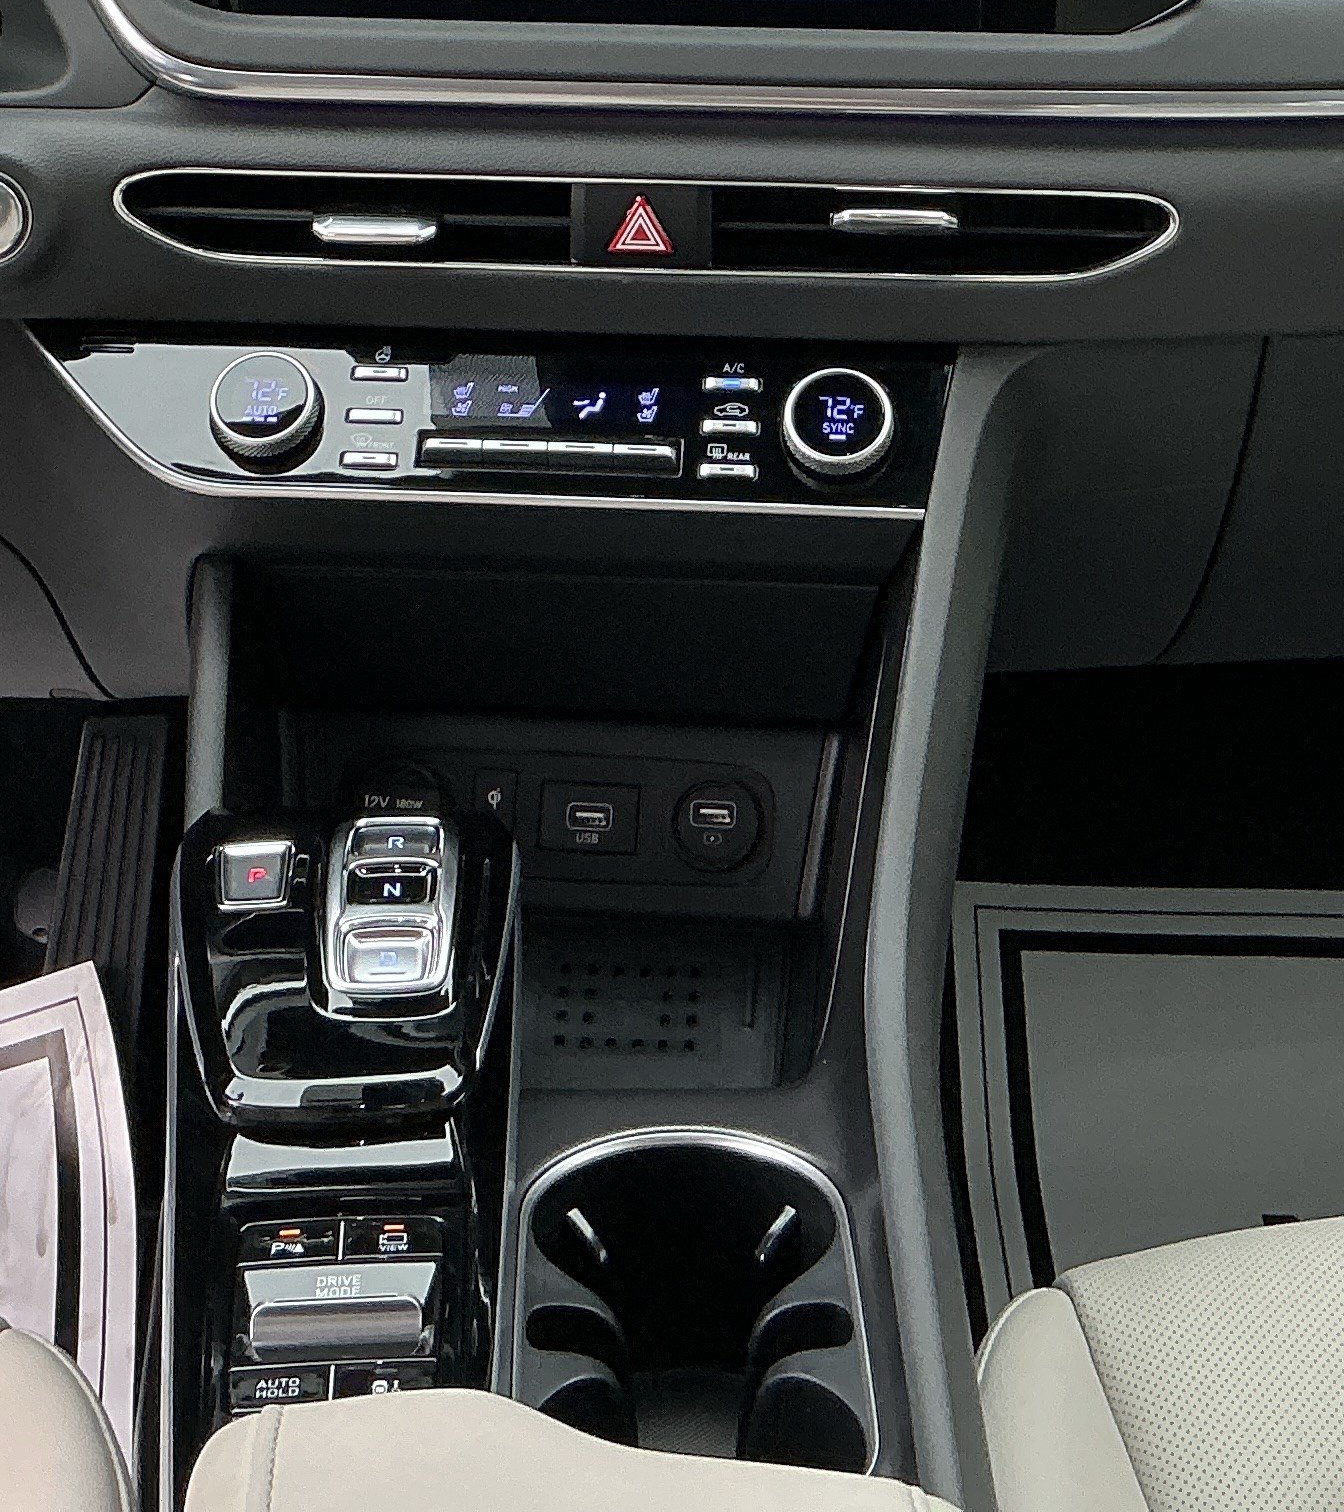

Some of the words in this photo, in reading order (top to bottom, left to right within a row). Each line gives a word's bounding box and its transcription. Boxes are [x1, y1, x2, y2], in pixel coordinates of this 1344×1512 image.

[722, 362, 745, 374] A/C
[365, 395, 387, 406] OFF
[243, 404, 278, 417] AUTO
[822, 422, 855, 435] SYNC
[726, 451, 751, 462] REAR
[363, 793, 390, 809] 12V
[387, 836, 405, 849] R
[575, 832, 600, 845] USB
[248, 867, 267, 884] P
[383, 882, 402, 898] N
[378, 950, 398, 967] D
[378, 1243, 409, 1253] VIEW
[316, 1273, 363, 1288] DRIVE
[315, 1286, 361, 1298] MODE
[255, 1376, 301, 1389] AUTO
[255, 1387, 300, 1400] HOLD
